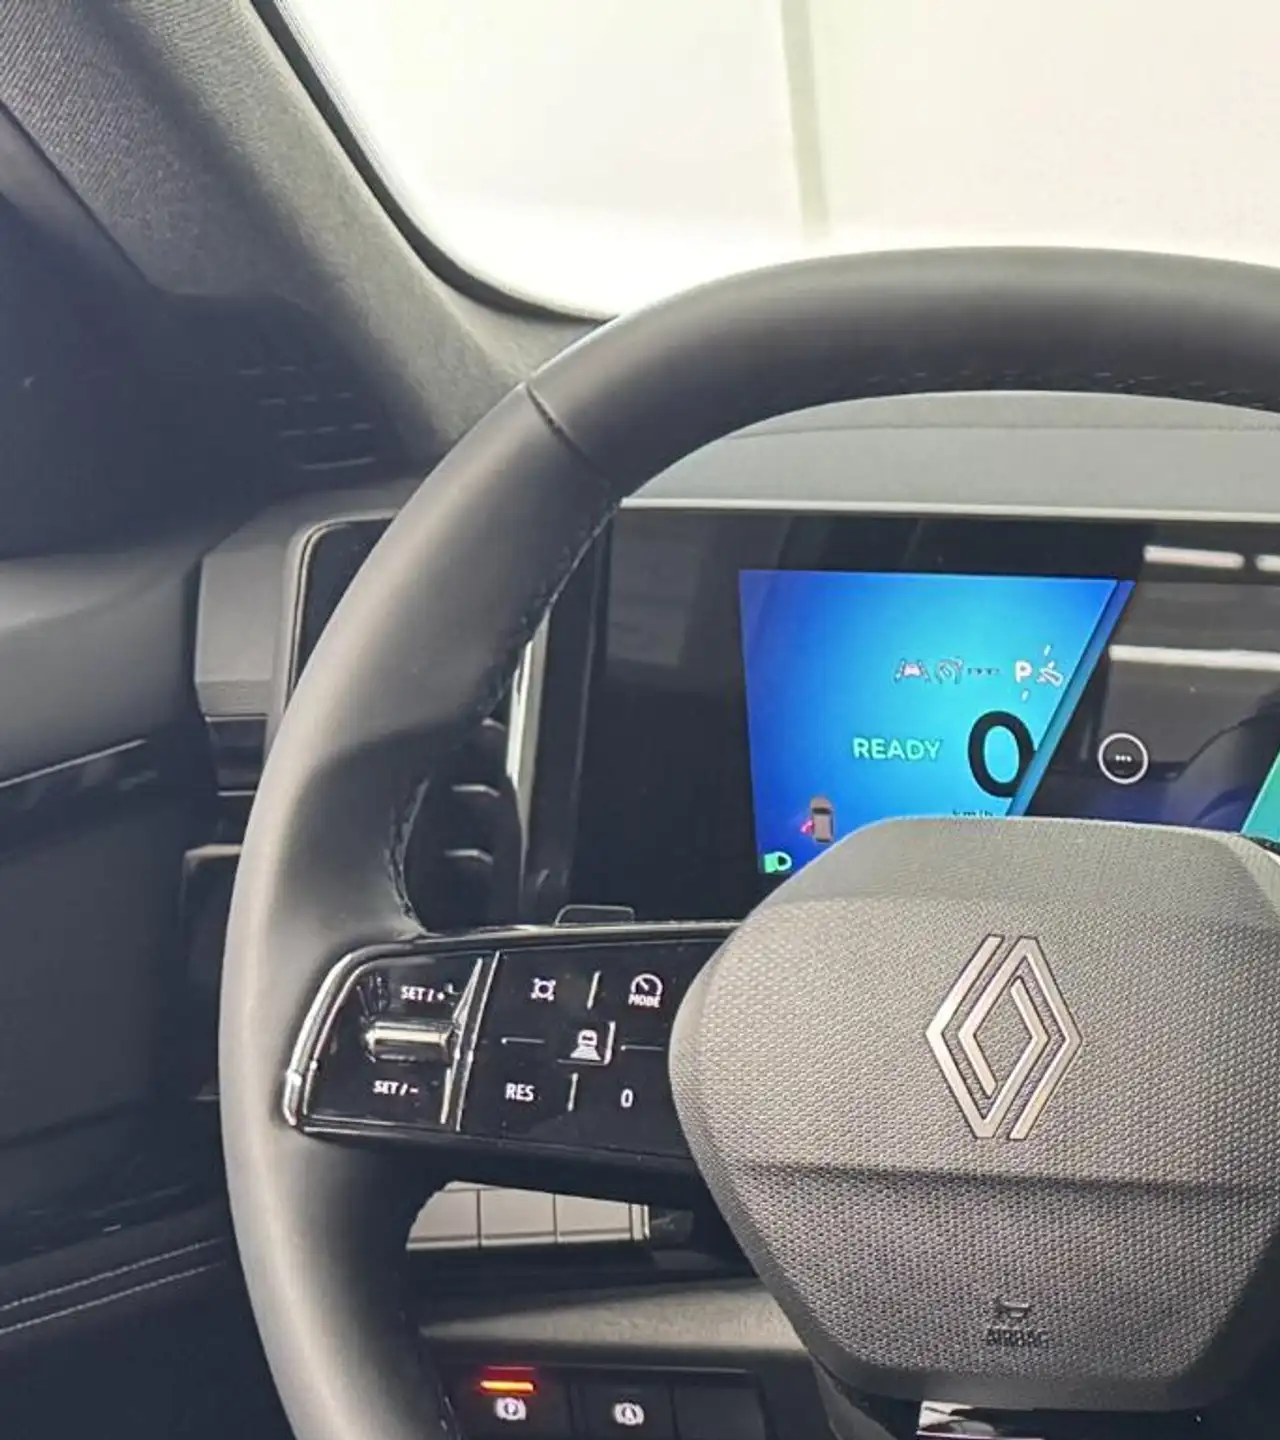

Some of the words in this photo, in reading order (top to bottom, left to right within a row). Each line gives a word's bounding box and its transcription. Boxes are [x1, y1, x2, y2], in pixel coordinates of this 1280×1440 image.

[1015, 660, 1033, 682] P
[851, 737, 943, 761] READY
[967, 710, 1038, 798] 0
[401, 985, 426, 1001] SET
[628, 993, 661, 1008] MODE
[373, 1080, 399, 1095] SET
[505, 1082, 536, 1102] RES
